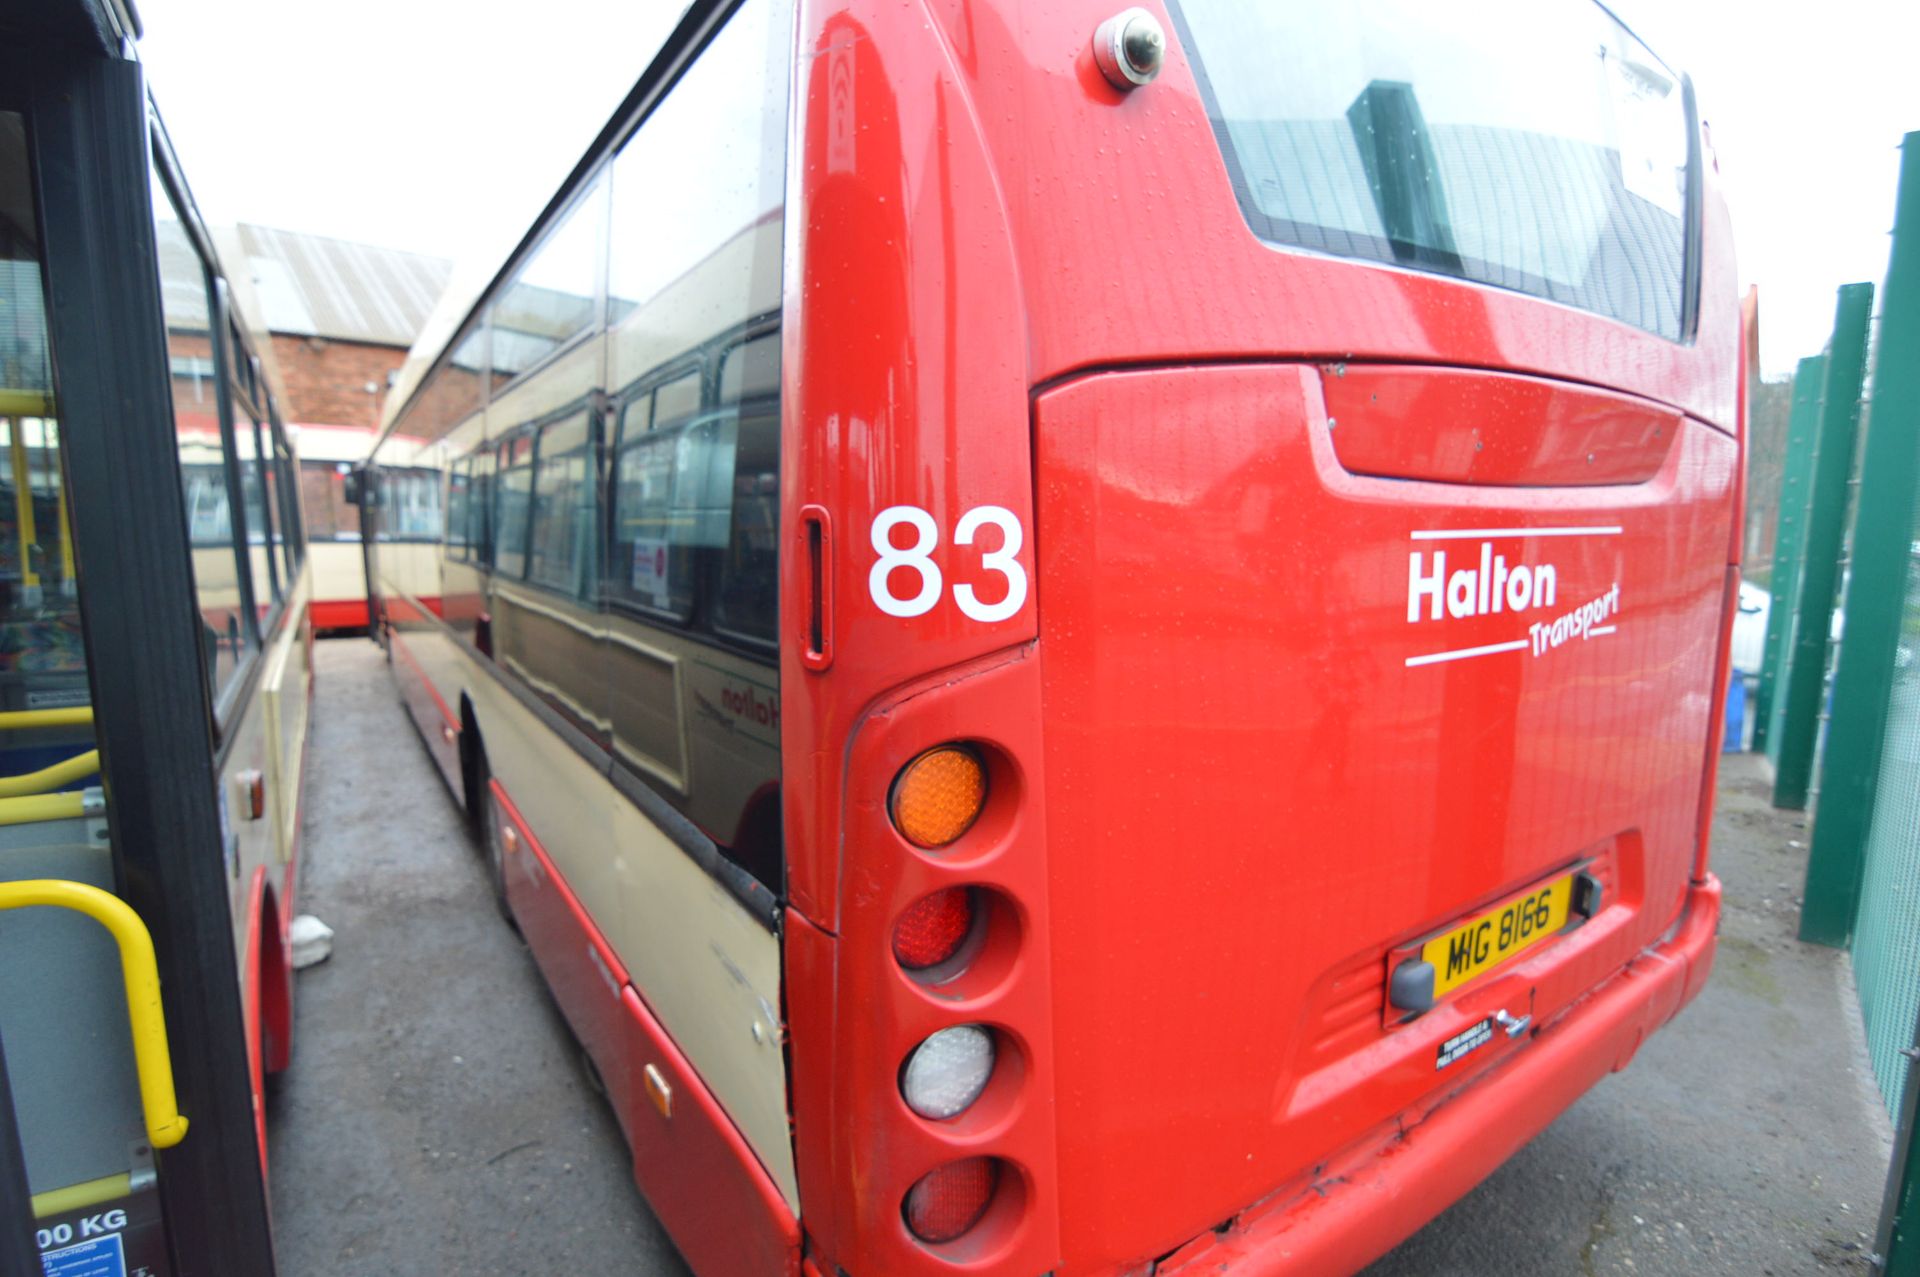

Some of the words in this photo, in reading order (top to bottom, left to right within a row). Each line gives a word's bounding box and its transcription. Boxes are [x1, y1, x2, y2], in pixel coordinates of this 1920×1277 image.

[868, 505, 1028, 623] 83
[1406, 542, 1557, 623] Halton
[1528, 582, 1620, 658] Transport
[1497, 888, 1552, 952] 8166
[80, 1208, 128, 1237] KG
